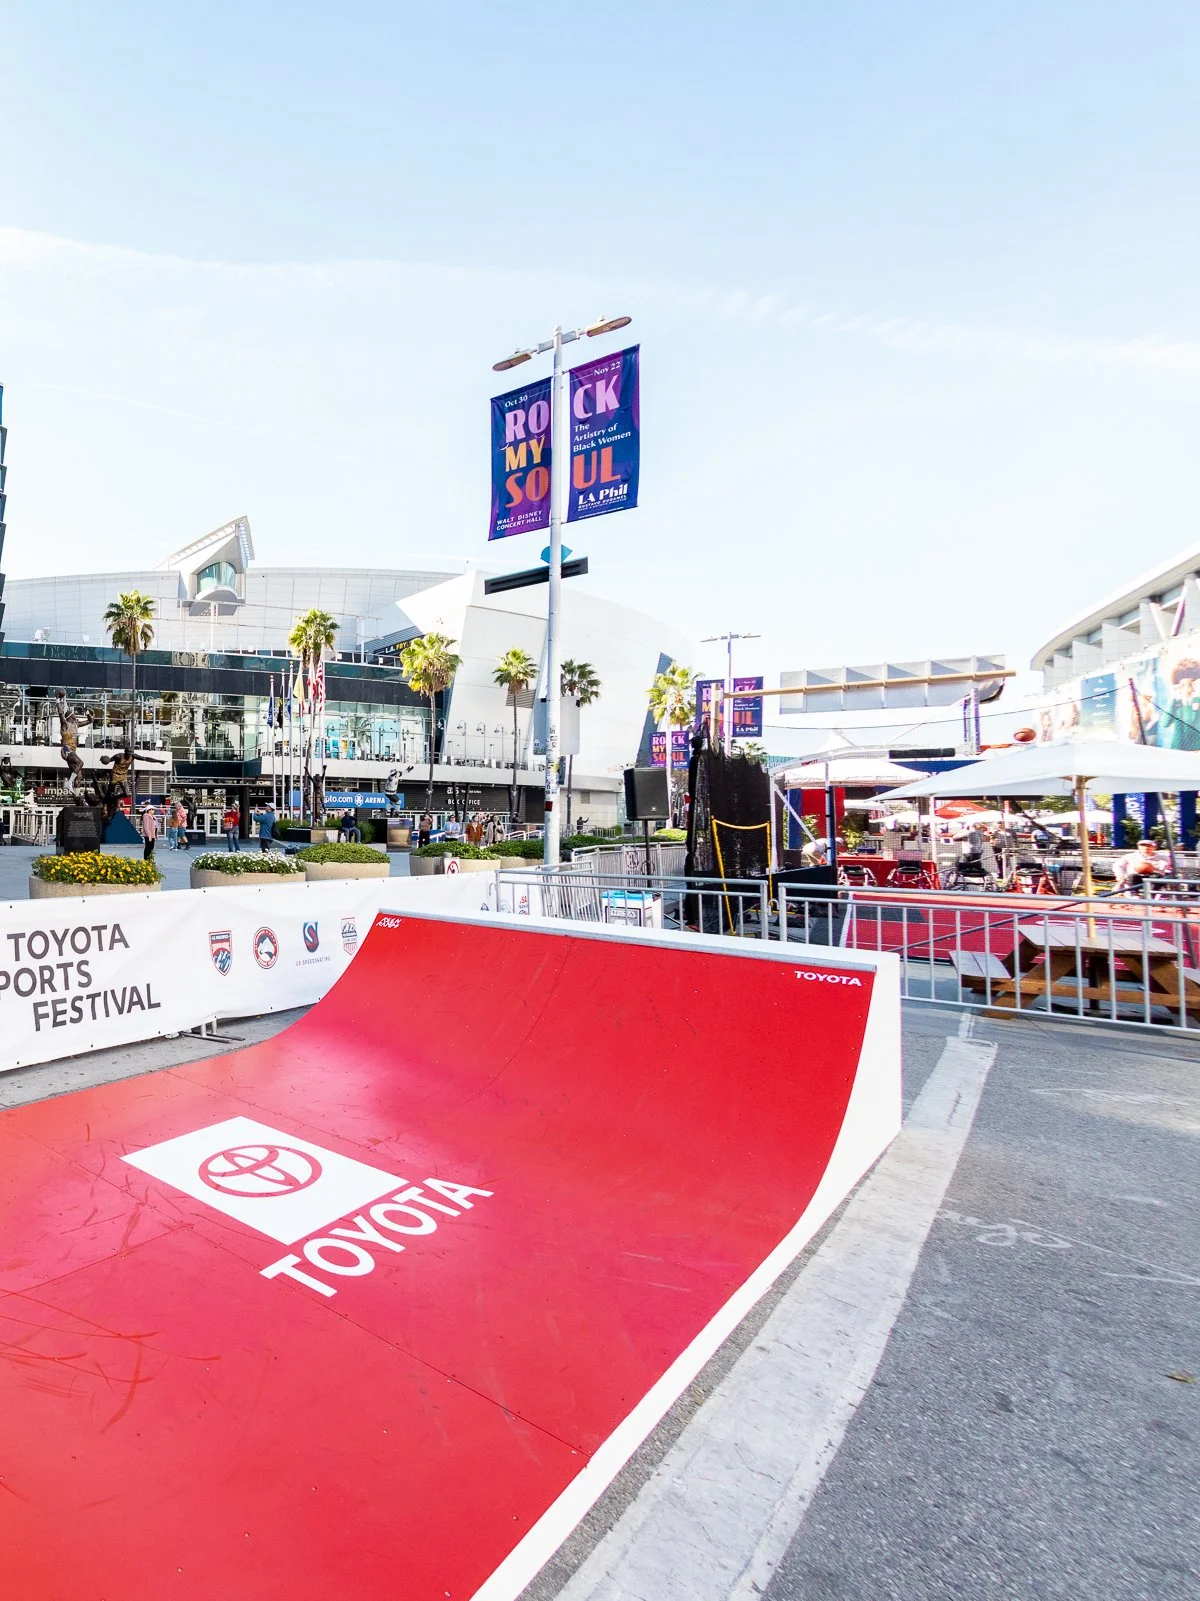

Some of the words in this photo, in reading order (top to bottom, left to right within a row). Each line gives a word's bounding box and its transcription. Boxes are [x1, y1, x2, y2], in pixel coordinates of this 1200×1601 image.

[594, 366, 609, 376] Nov
[610, 361, 621, 371] 22
[505, 399, 517, 408] Oct
[573, 374, 620, 419] CK
[505, 400, 549, 443] RO
[574, 423, 590, 432] The
[573, 428, 606, 442] Artistry
[607, 423, 618, 432] of
[573, 440, 596, 452] Black
[598, 431, 631, 445] Women
[505, 436, 545, 472] MY
[573, 446, 621, 489] UL
[505, 466, 549, 508] SO
[578, 492, 596, 505] LA
[599, 483, 628, 500] Phil
[496, 519, 525, 531] CONCERT
[526, 516, 543, 525] HALL
[497, 516, 514, 525] WALT
[517, 510, 543, 520] DISNEY
[652, 745, 665, 753] MY
[6, 923, 130, 962] TOYOTA
[794, 970, 862, 987] TOYOTA
[33, 983, 161, 1032] FESTIVAL
[258, 1177, 495, 1298] TOYOTA
